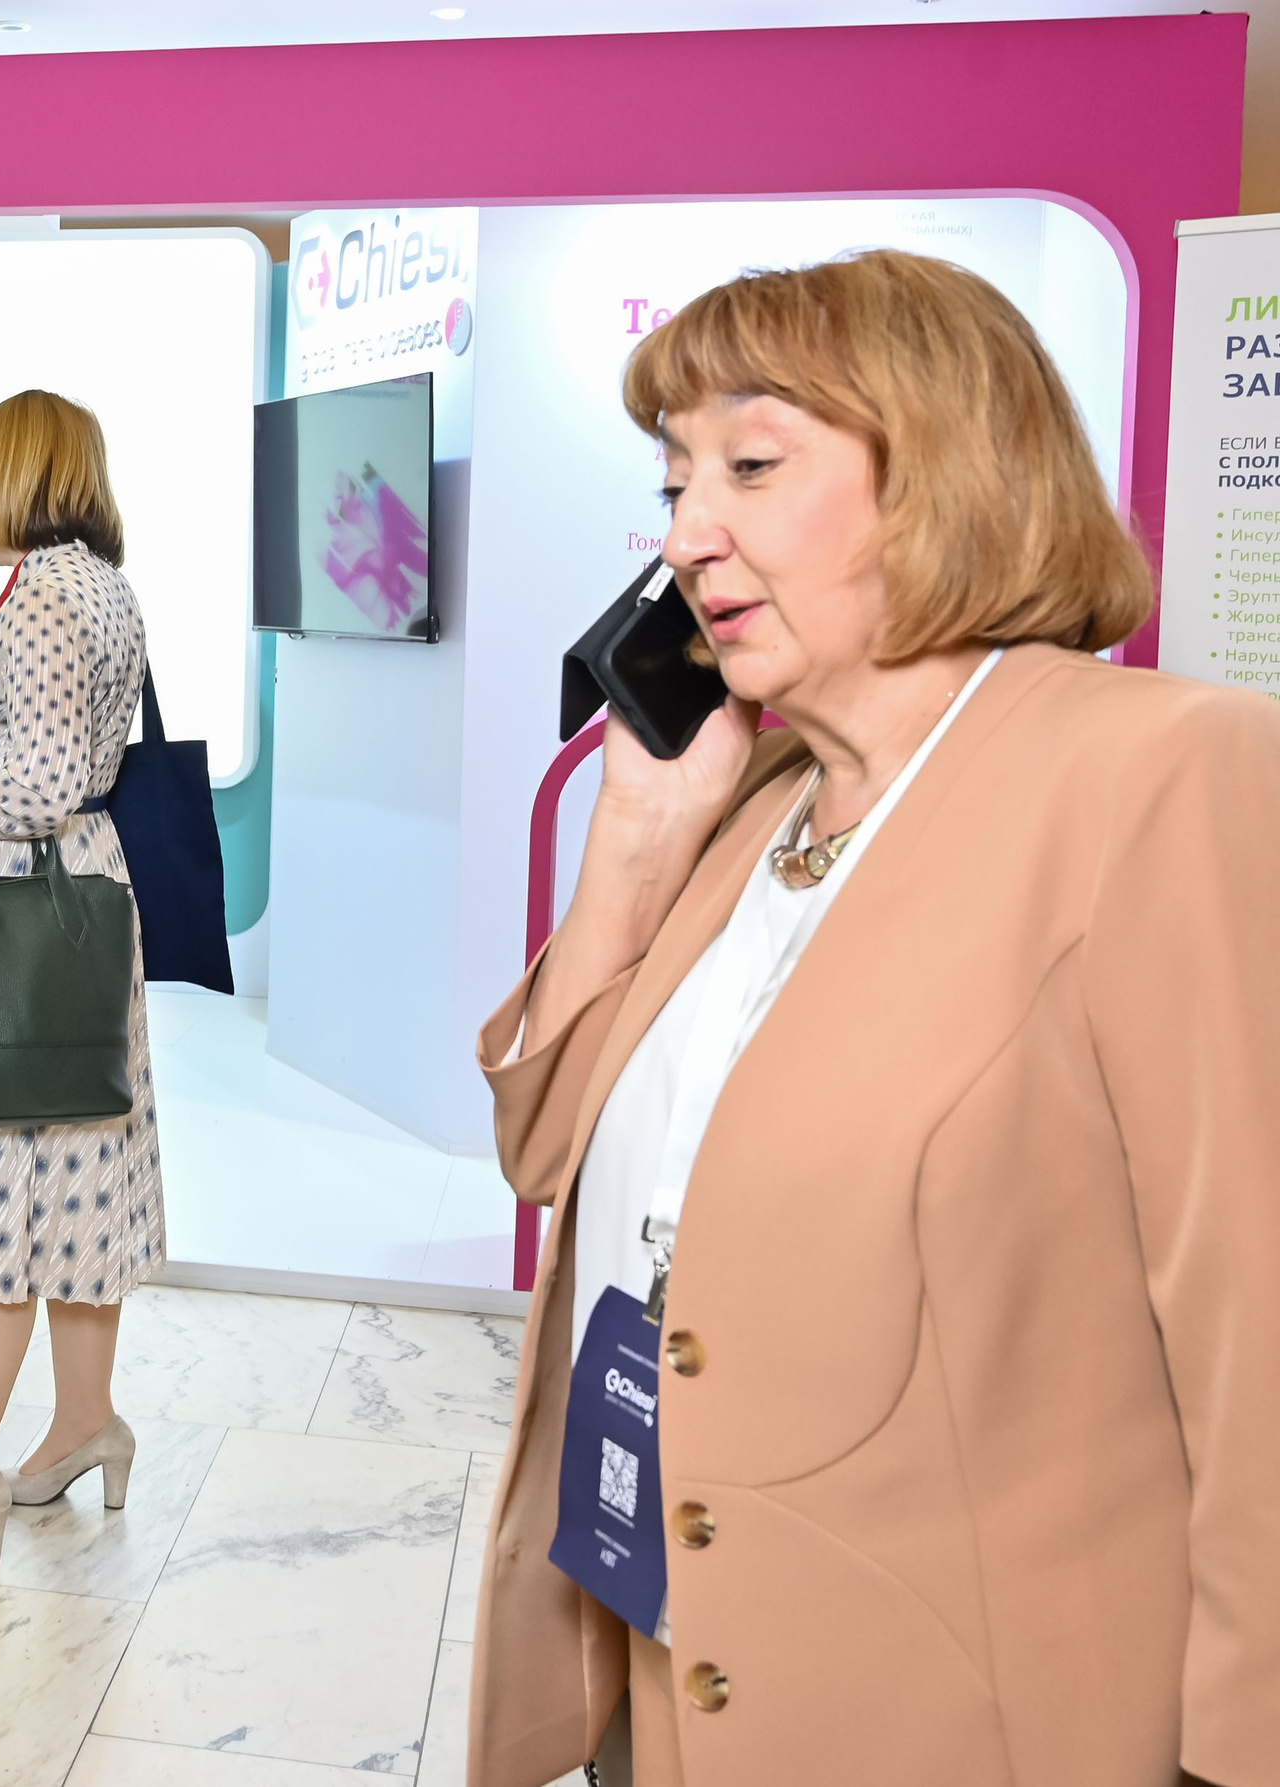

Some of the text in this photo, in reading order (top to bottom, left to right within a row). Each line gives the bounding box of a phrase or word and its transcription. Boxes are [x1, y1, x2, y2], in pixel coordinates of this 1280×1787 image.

[335, 214, 463, 310] Chiesi
[1220, 437, 1267, 450] ЕСЛИ
[1232, 508, 1280, 524] Гипер
[1230, 549, 1280, 565] Гипер
[1227, 589, 1280, 606] Эрупт
